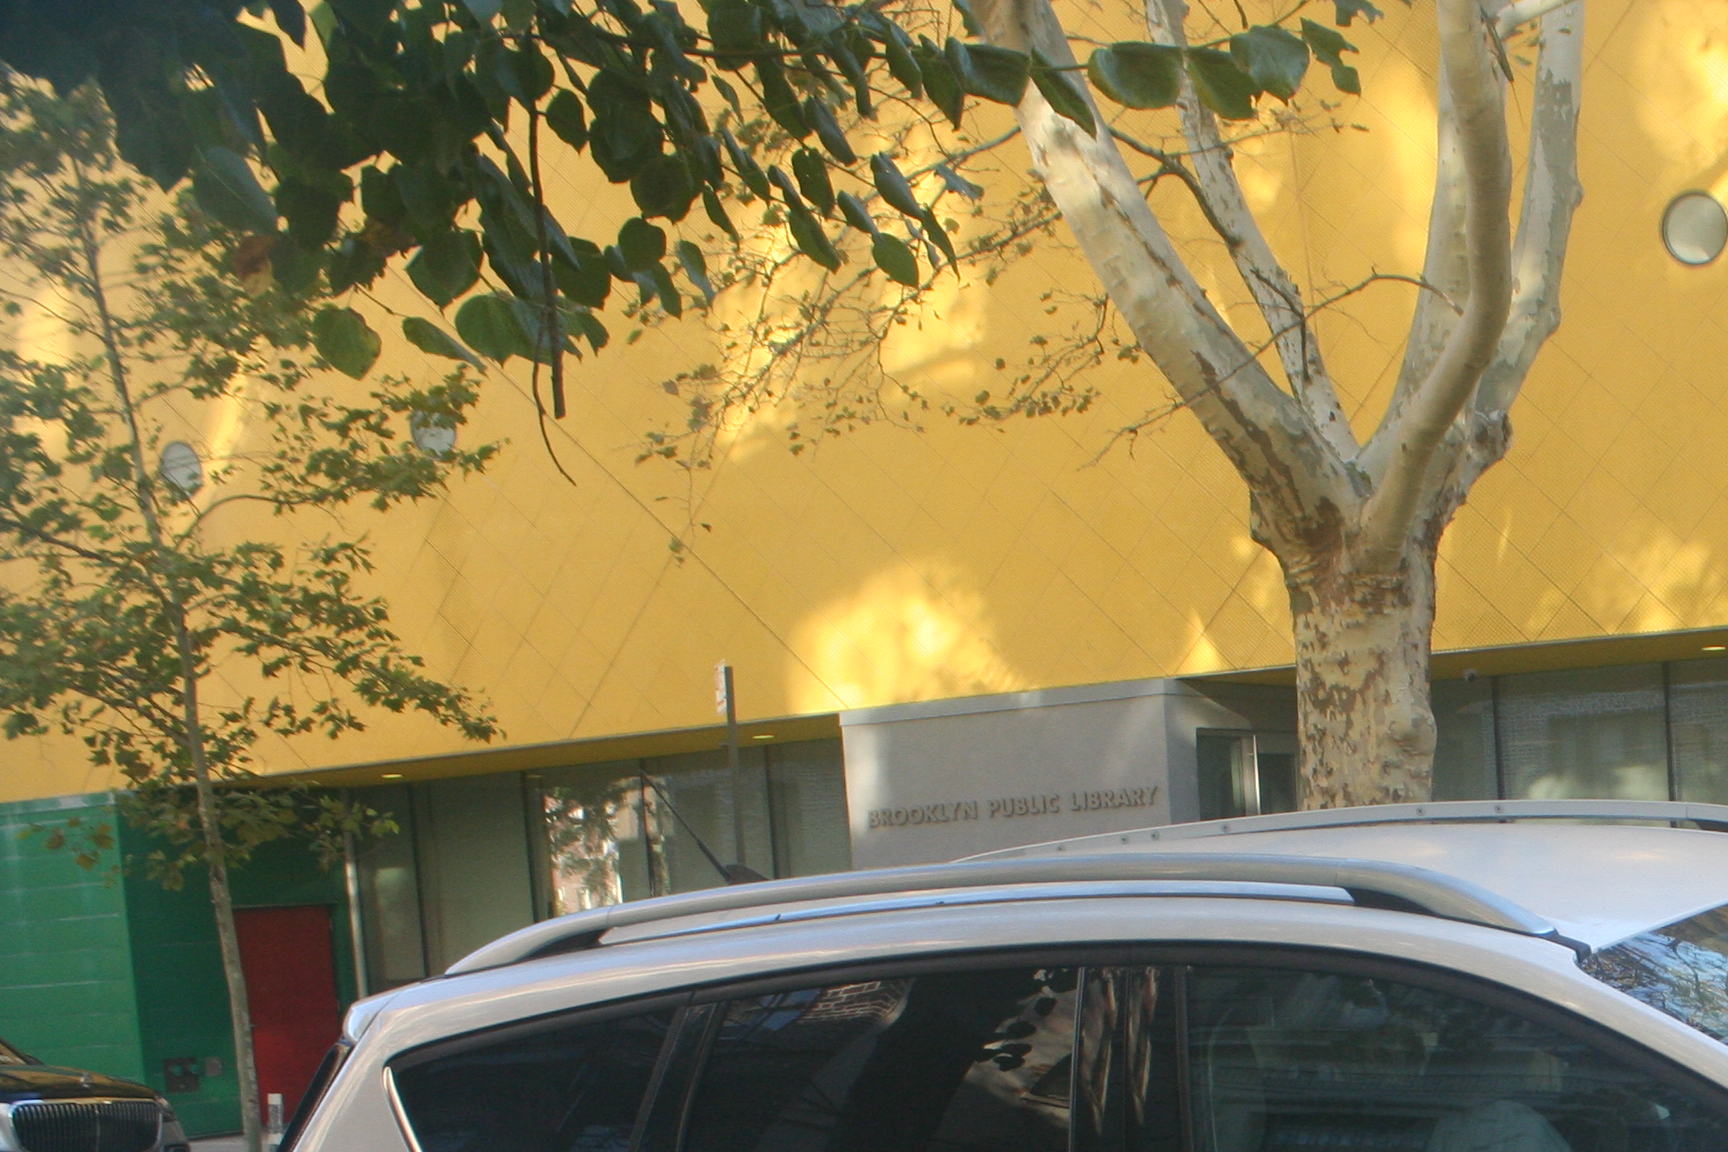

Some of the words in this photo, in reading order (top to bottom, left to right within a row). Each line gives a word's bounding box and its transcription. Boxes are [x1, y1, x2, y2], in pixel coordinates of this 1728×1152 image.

[868, 800, 978, 828] BROOKLYN
[988, 793, 1060, 818] PUBLIC
[1071, 786, 1159, 812] LIBRARY
